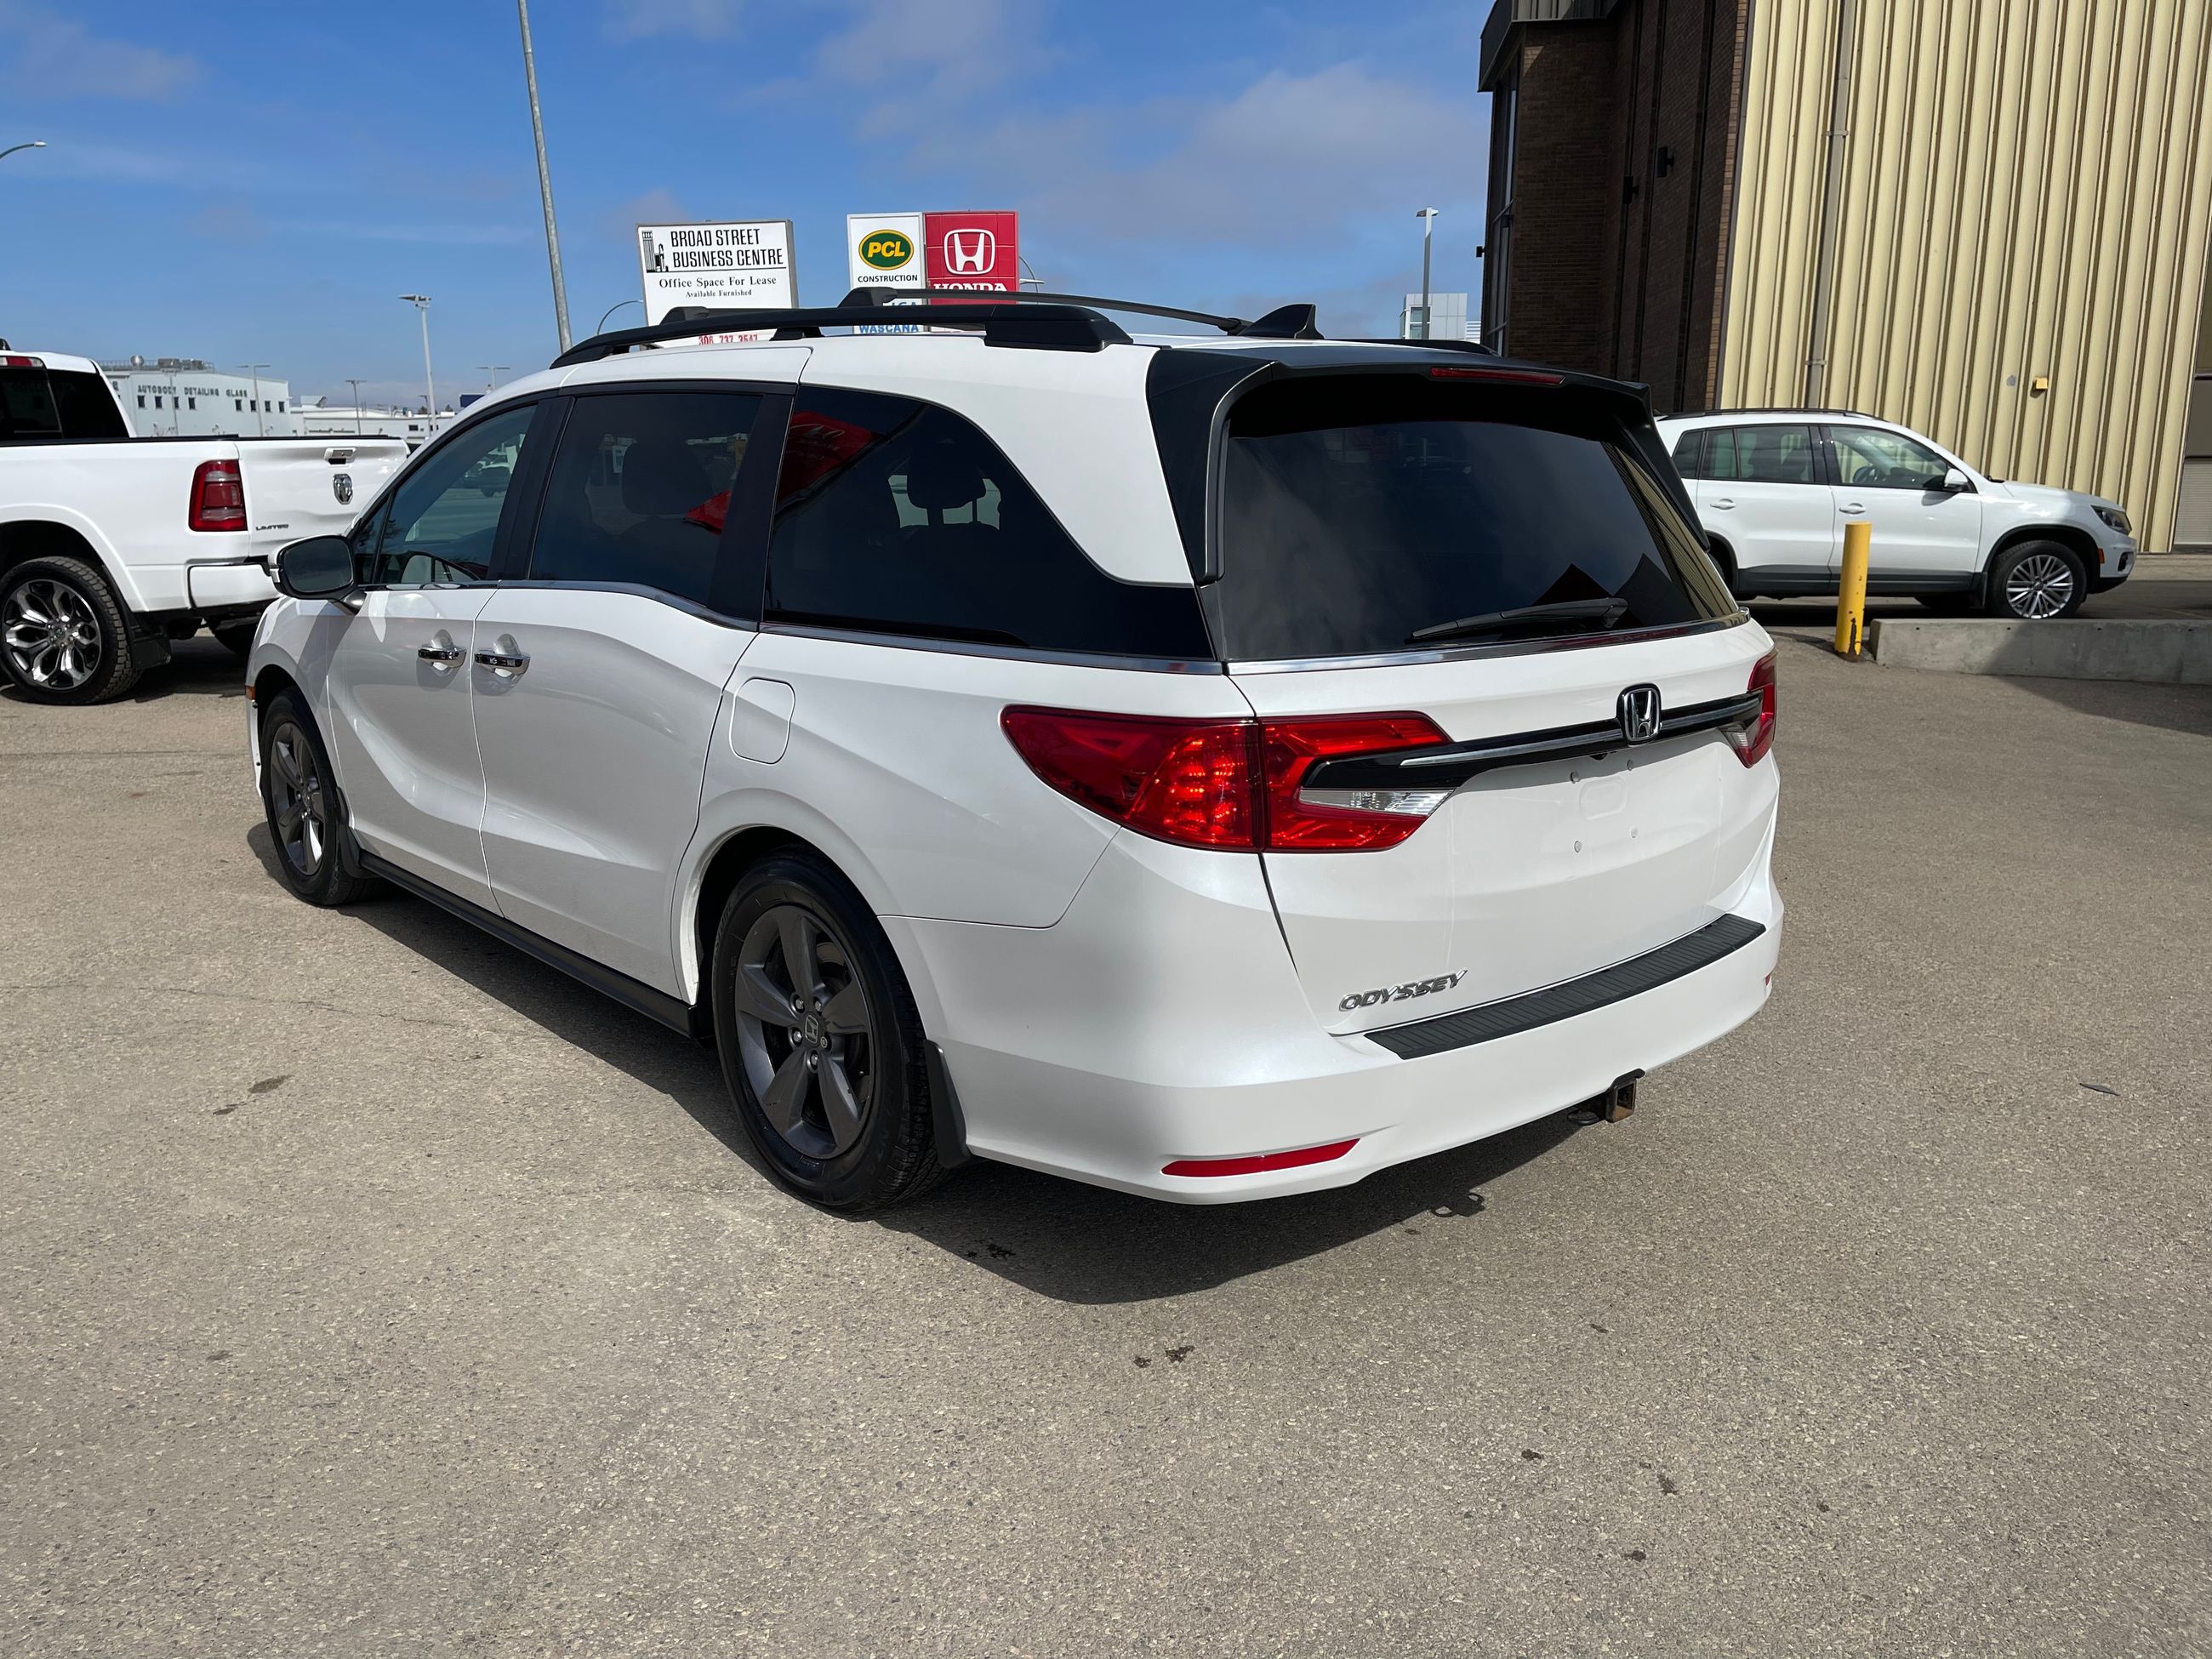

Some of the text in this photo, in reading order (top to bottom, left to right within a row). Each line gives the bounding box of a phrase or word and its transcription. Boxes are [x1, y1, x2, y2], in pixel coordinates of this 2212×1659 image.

[670, 228, 761, 248] BROAD STREET
[867, 242, 905, 258] PCL
[673, 248, 784, 268] BUSINESS CENTRE
[658, 275, 777, 288] Office Space For Lease
[858, 274, 918, 283] CONSTRUCTION
[686, 289, 715, 298] Available
[859, 324, 919, 334] WASCANA
[138, 385, 248, 397] AUTOBODY DETAILING GLASS
[1339, 967, 1468, 1012] ODYSSEY
